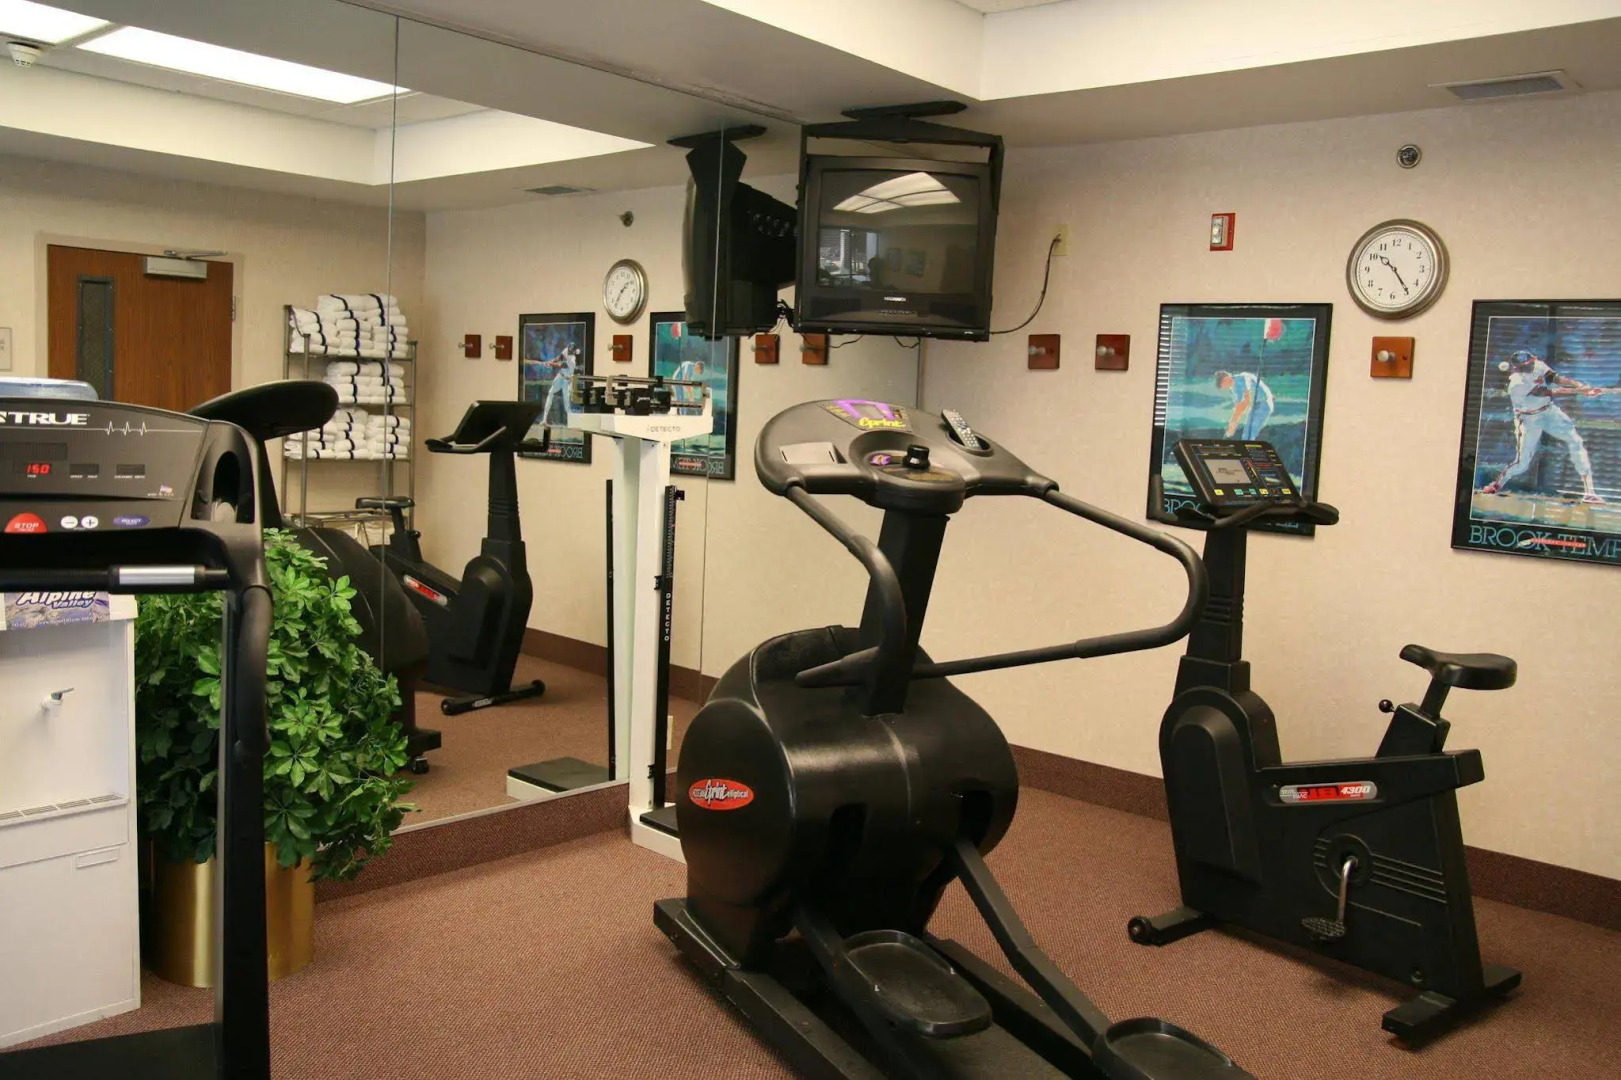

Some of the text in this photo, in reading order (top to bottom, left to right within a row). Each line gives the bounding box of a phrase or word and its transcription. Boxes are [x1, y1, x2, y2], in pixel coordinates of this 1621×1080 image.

[1379, 243, 1387, 251] 11
[1392, 239, 1402, 247] 12
[1369, 253, 1378, 261] 10
[1416, 251, 1422, 259] 2
[1419, 265, 1425, 273] 3
[1413, 279, 1419, 287] 4
[1378, 287, 1383, 296] 7
[1389, 292, 1395, 300] 6
[1468, 524, 1552, 551] BROOK
[52, 599, 94, 609] Valley
[664, 592, 672, 641] DETECTO
[1340, 785, 1371, 795] 4300
